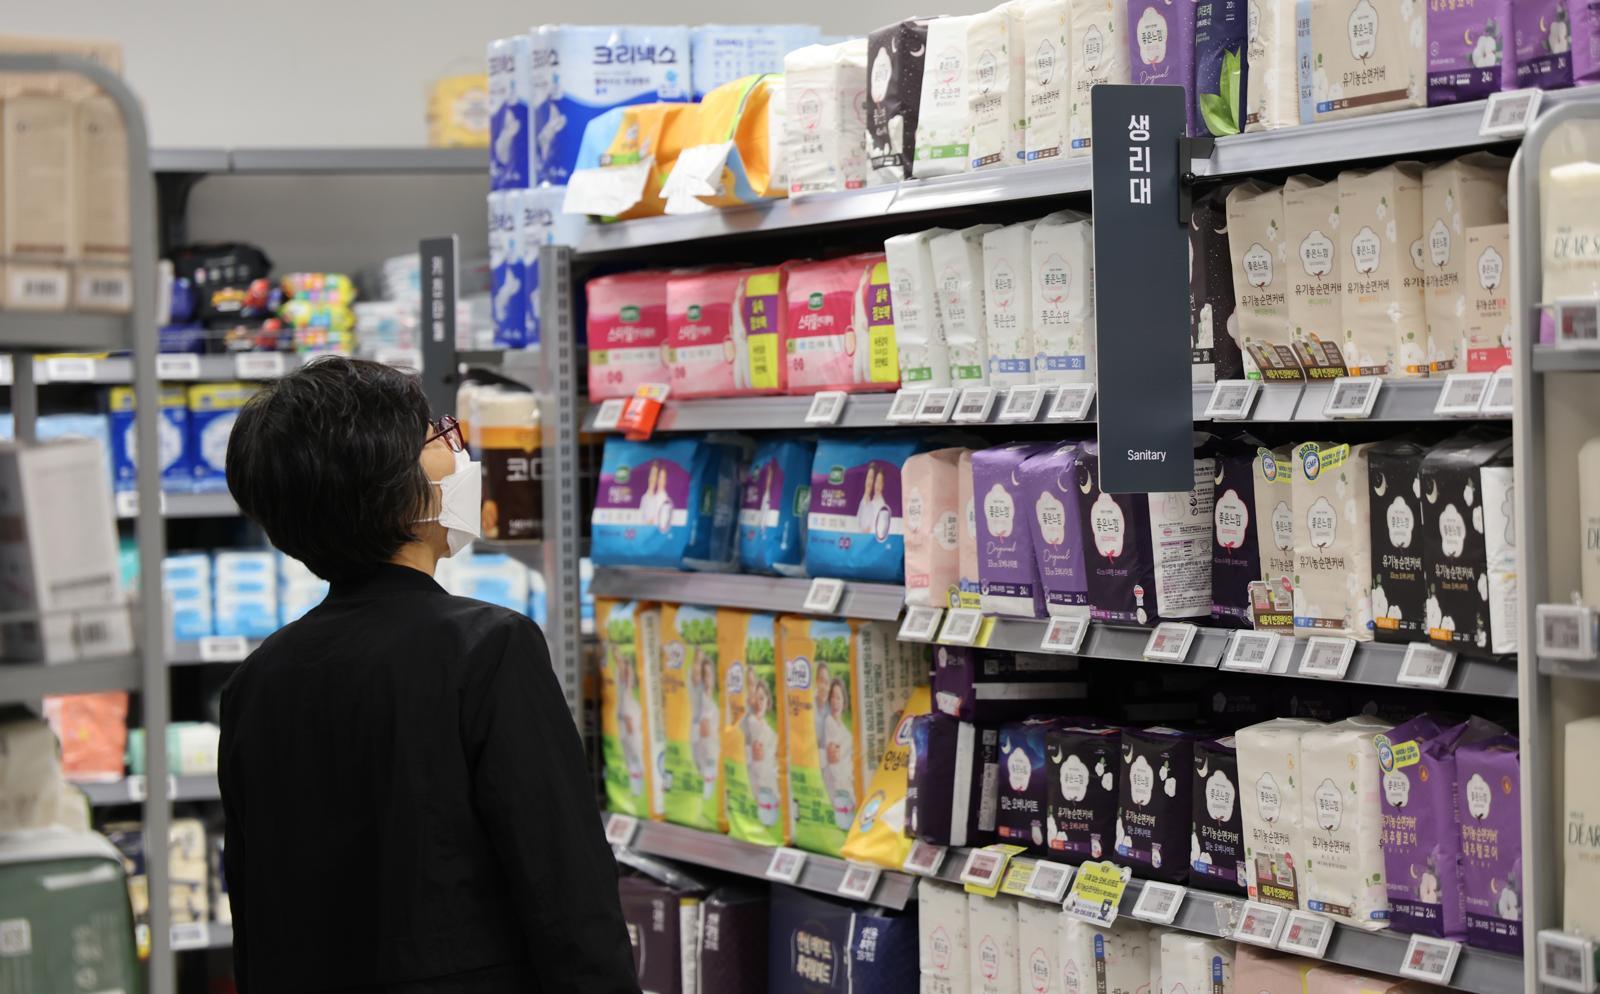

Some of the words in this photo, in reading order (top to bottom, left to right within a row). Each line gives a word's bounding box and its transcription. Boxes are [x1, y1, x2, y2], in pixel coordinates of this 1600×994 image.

[594, 45, 678, 66] 크리넥스
[1343, 65, 1386, 87] 유기농순면커버
[1128, 114, 1152, 205] 생리대
[1295, 282, 1342, 298] 유기농순면커버
[1347, 278, 1390, 294] 유기농순면커버
[1242, 293, 1285, 308] 유기농순면커버
[1128, 449, 1166, 463] Sanitary
[1096, 517, 1119, 533] 좋은느낌
[1218, 511, 1242, 527] 좋은느낌
[1300, 556, 1346, 571] 유기농순면커버
[1381, 554, 1423, 571] 유기농순면커버
[1435, 564, 1476, 582] 유기농순면커버
[1013, 797, 1038, 813] 오버나이트
[1057, 806, 1093, 821] 유기농순면커버
[1125, 808, 1155, 827] 유기농순면커버
[1201, 825, 1239, 845] 유기농순면커버
[1253, 827, 1289, 844] 유기농순면커버
[1384, 831, 1418, 850] 내추럴코어
[1461, 823, 1498, 844] 유기농순면커버
[1312, 835, 1352, 855] 유기농순면커버
[1463, 842, 1498, 862] 내추럴코어
